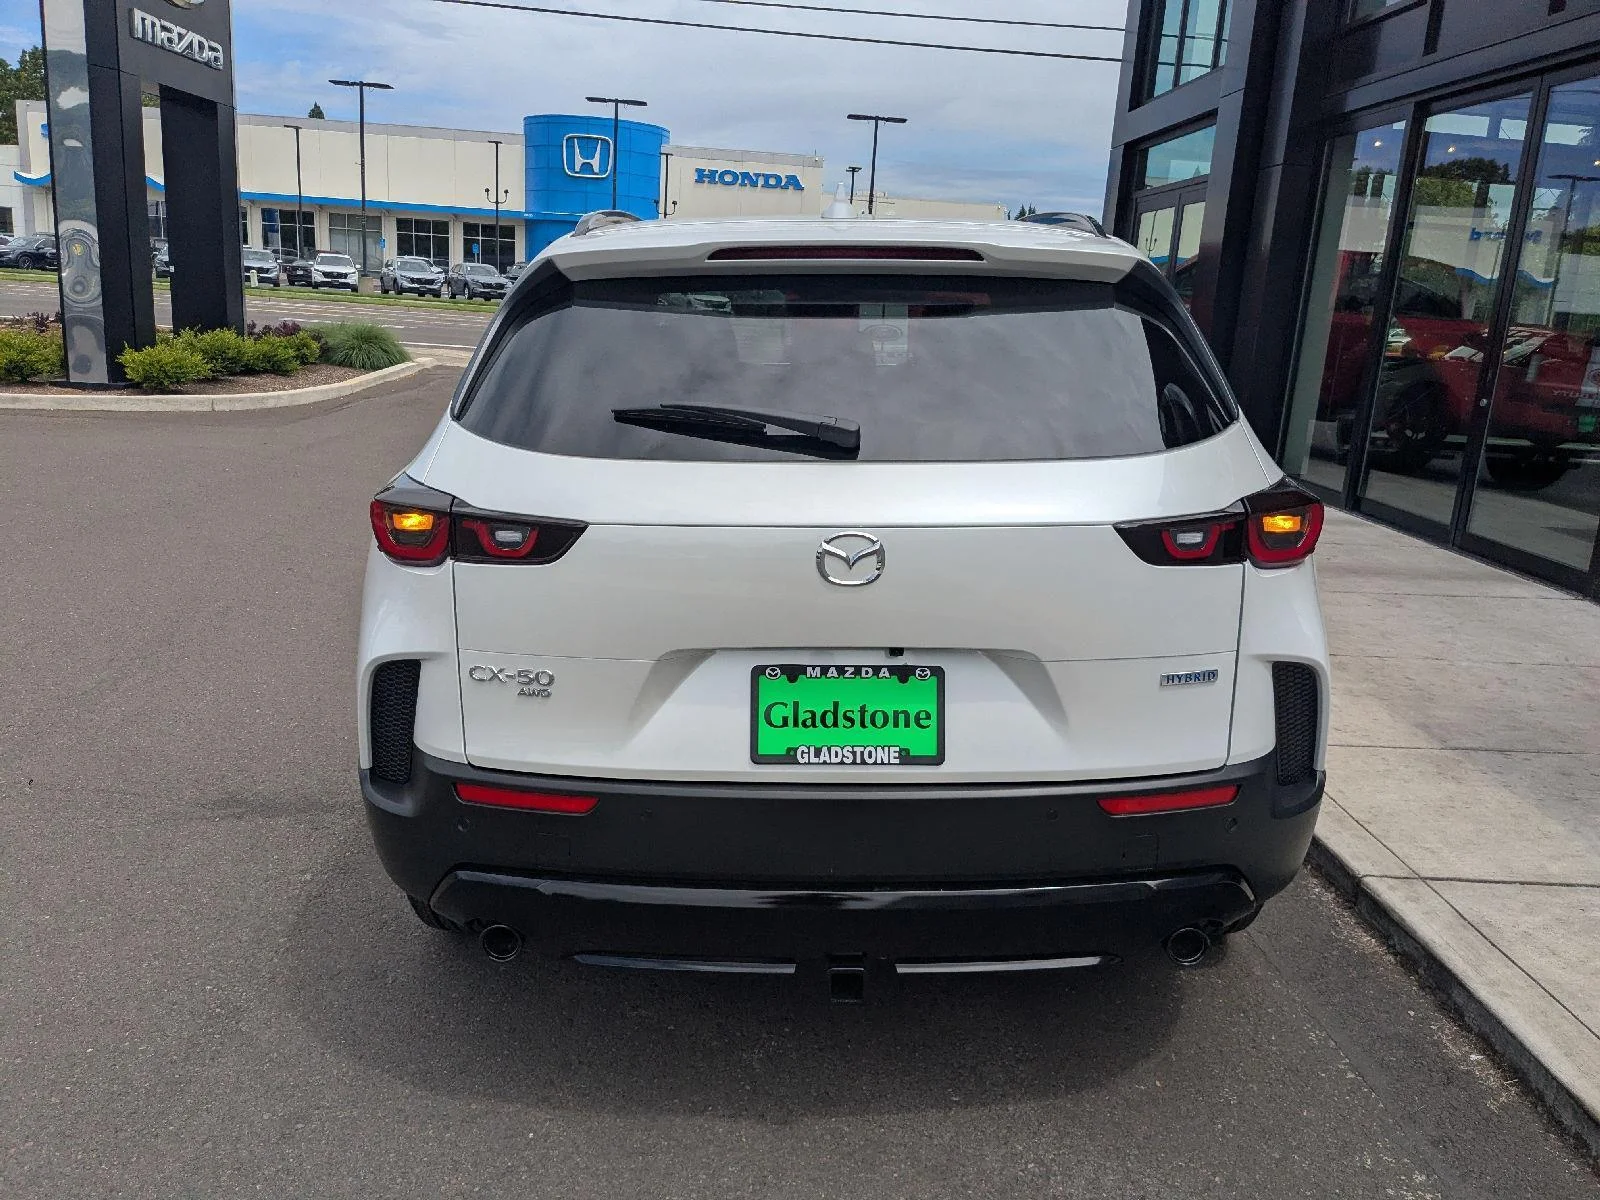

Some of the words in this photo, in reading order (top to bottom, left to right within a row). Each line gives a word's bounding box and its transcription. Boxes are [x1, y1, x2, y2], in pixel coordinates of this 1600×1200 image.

[695, 168, 805, 191] HONDA
[469, 664, 556, 687] CX-50
[806, 666, 891, 679] MAZDA
[1165, 670, 1217, 685] HYBRID
[517, 687, 553, 698] AWD
[763, 700, 932, 730] Gladstone
[796, 745, 900, 765] GLADSTONE
